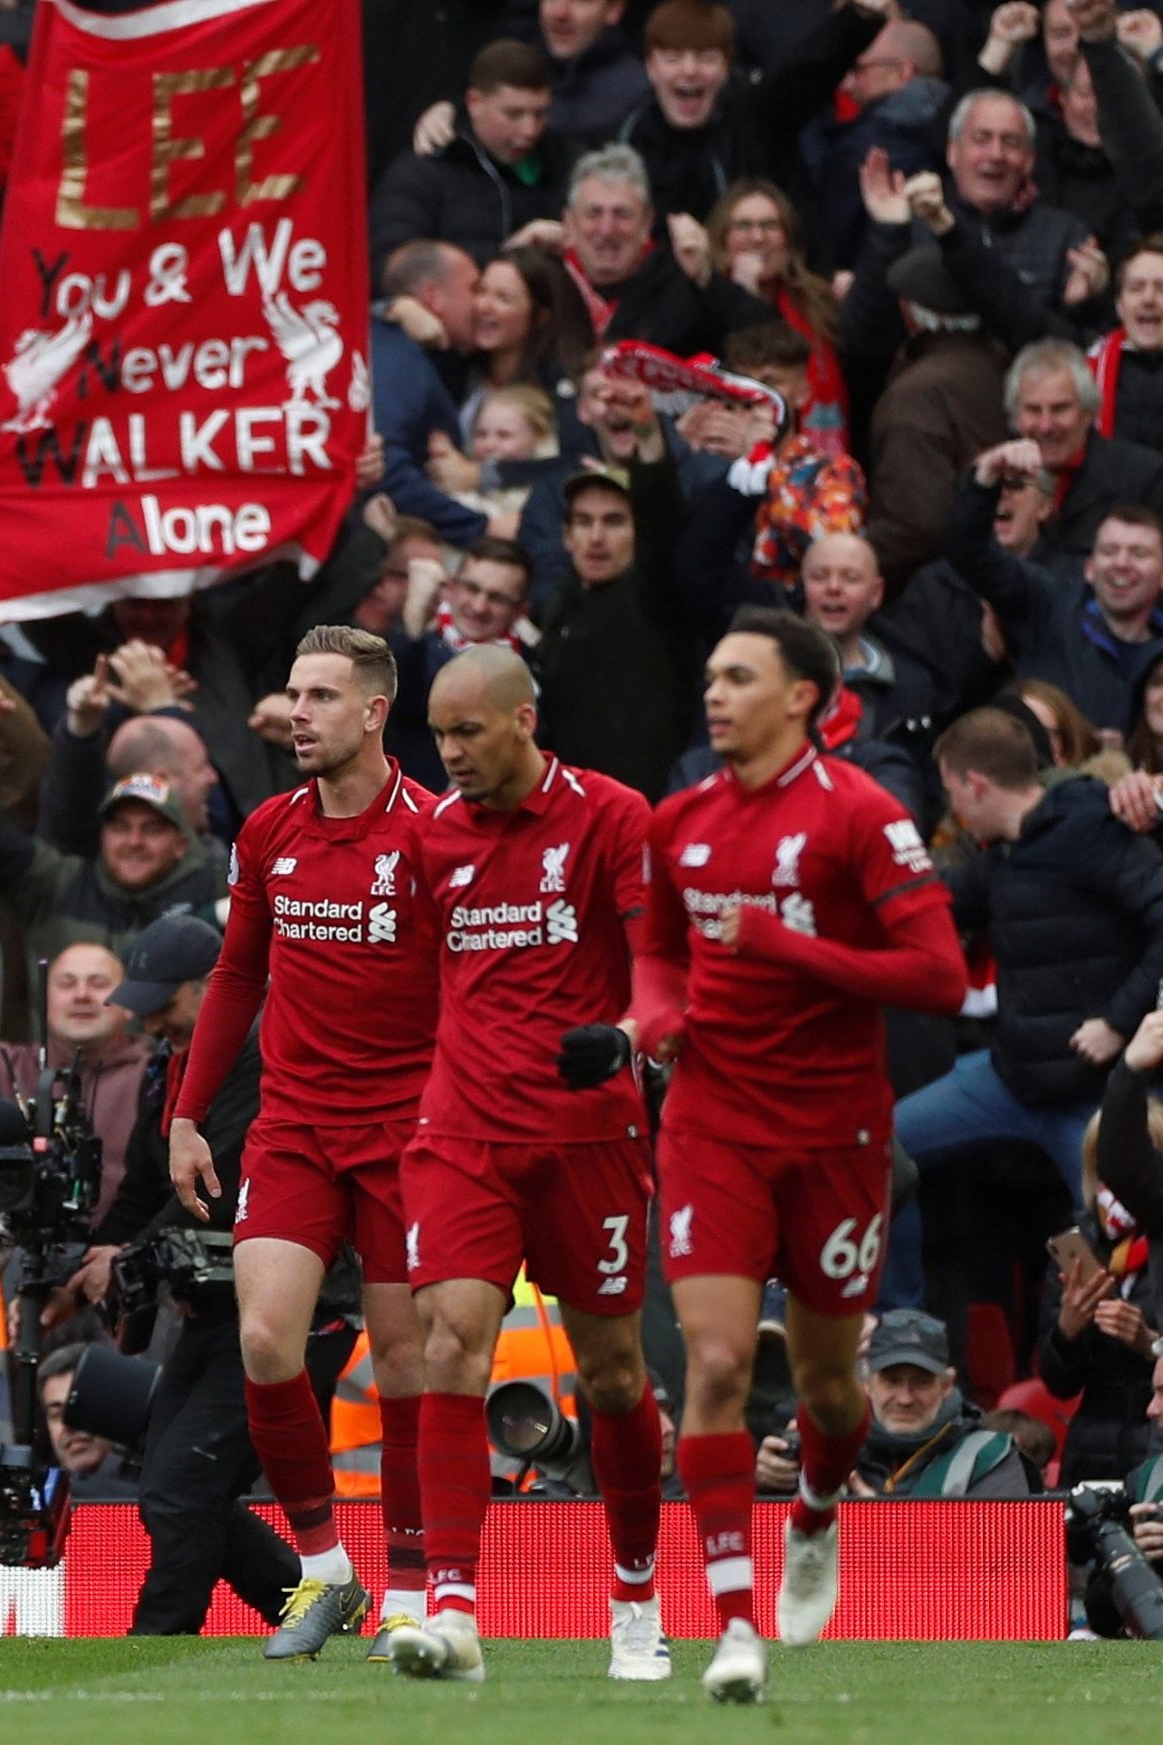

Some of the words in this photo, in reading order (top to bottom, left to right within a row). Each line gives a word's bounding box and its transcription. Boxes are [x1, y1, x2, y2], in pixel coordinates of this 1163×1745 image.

[55, 44, 321, 230] LEE
[33, 248, 131, 318] You
[144, 242, 193, 306] &
[218, 218, 327, 297] We
[77, 336, 269, 399] Never
[15, 404, 333, 490] WALKER
[106, 494, 272, 560] Alone
[274, 895, 363, 920] Standard
[447, 927, 542, 952] Chartered
[450, 901, 542, 928] Standard
[597, 1215, 630, 1275] 3
[820, 1212, 883, 1280] 66
